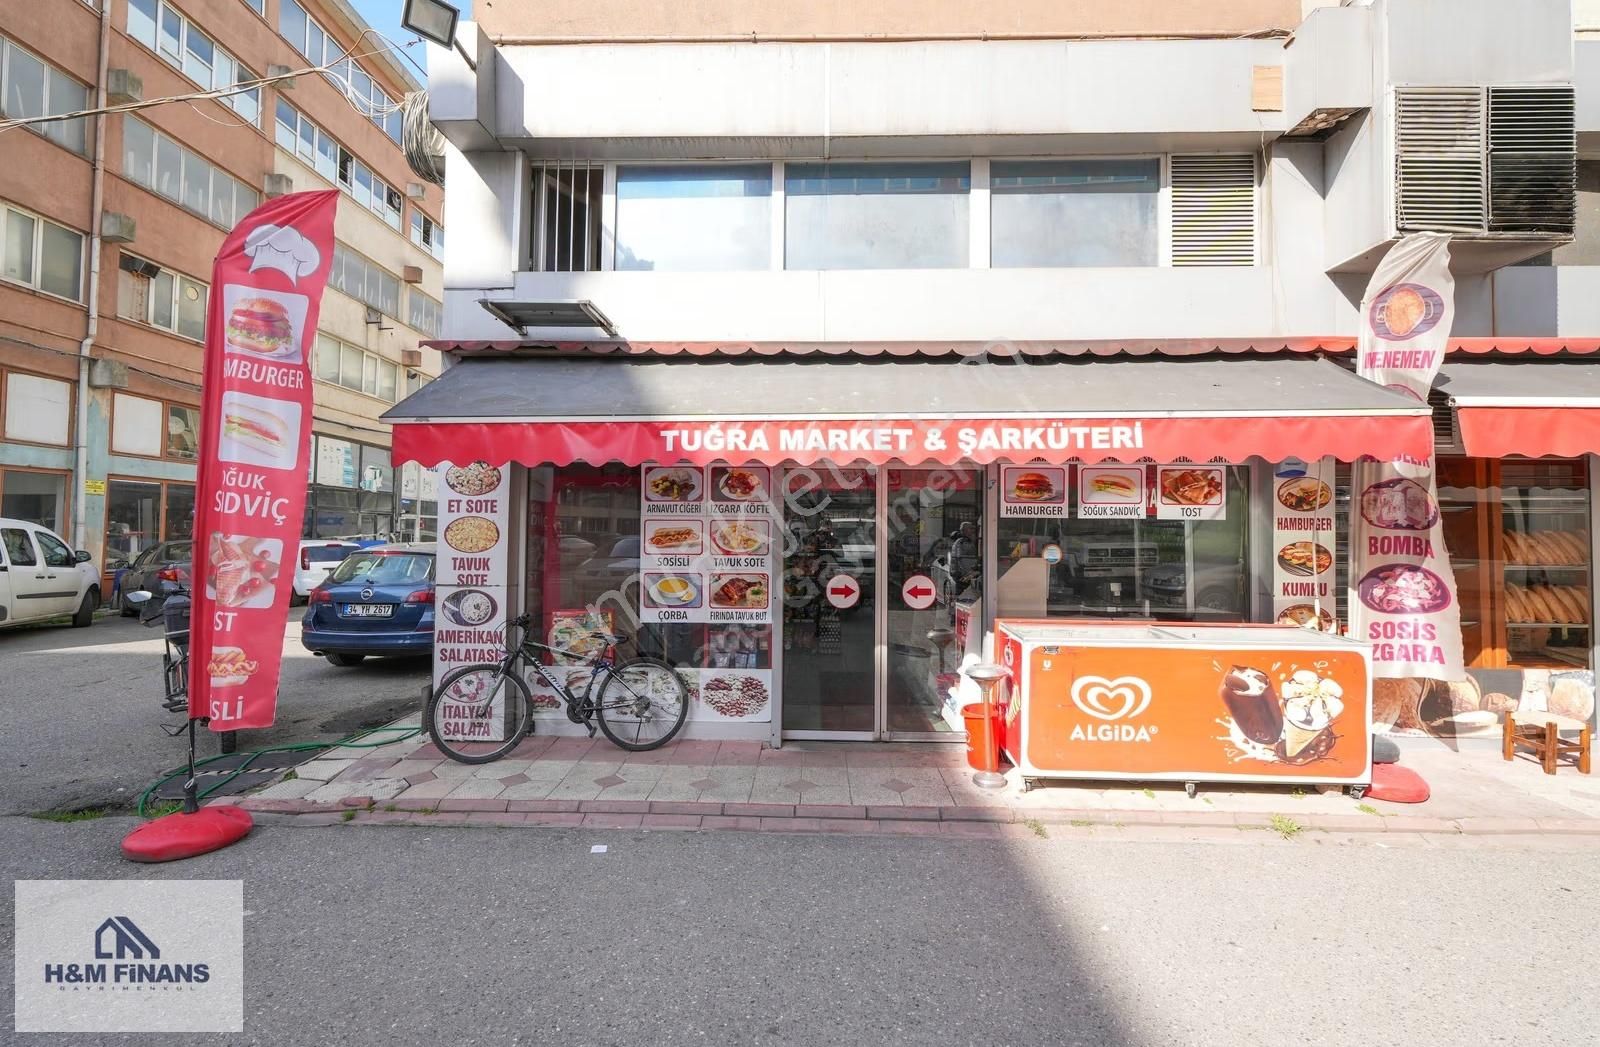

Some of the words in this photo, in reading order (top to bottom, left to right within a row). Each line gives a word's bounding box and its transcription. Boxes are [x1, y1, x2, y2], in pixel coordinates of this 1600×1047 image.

[224, 358, 304, 389] MBURGER
[660, 424, 769, 451] TUĞRA
[779, 428, 913, 451] MARKET
[923, 428, 947, 450] &
[958, 421, 1144, 456] ŞARKÜTERİ
[222, 467, 267, 490] ĞUK
[447, 499, 462, 513] ET
[466, 499, 498, 514] SOTE
[647, 504, 680, 513] ARNAVUT
[680, 502, 702, 514] CİĞERİ
[1005, 505, 1063, 516] HAMBURGER
[1083, 504, 1108, 516] SOĞUK
[1109, 504, 1141, 518] SANDVİÇ
[1180, 507, 1202, 517] TOST
[1277, 517, 1332, 531] HAMBURGER
[1368, 535, 1435, 559] BOMBA
[452, 557, 491, 571] TAVUK
[657, 555, 690, 567] SOSİSLİ
[714, 557, 741, 567] TAVUK
[744, 557, 765, 567] SOTE
[457, 574, 488, 587] SOTE
[348, 605, 357, 614] 34
[658, 610, 688, 622] ÇORBA
[710, 611, 735, 621] FIRINDA
[735, 611, 754, 621] TAVUK
[755, 611, 767, 621] BUT
[436, 627, 503, 645] AMERİKAN
[1368, 618, 1436, 641] SOSİS
[210, 695, 244, 721] SLİ
[443, 722, 491, 737] SALATA
